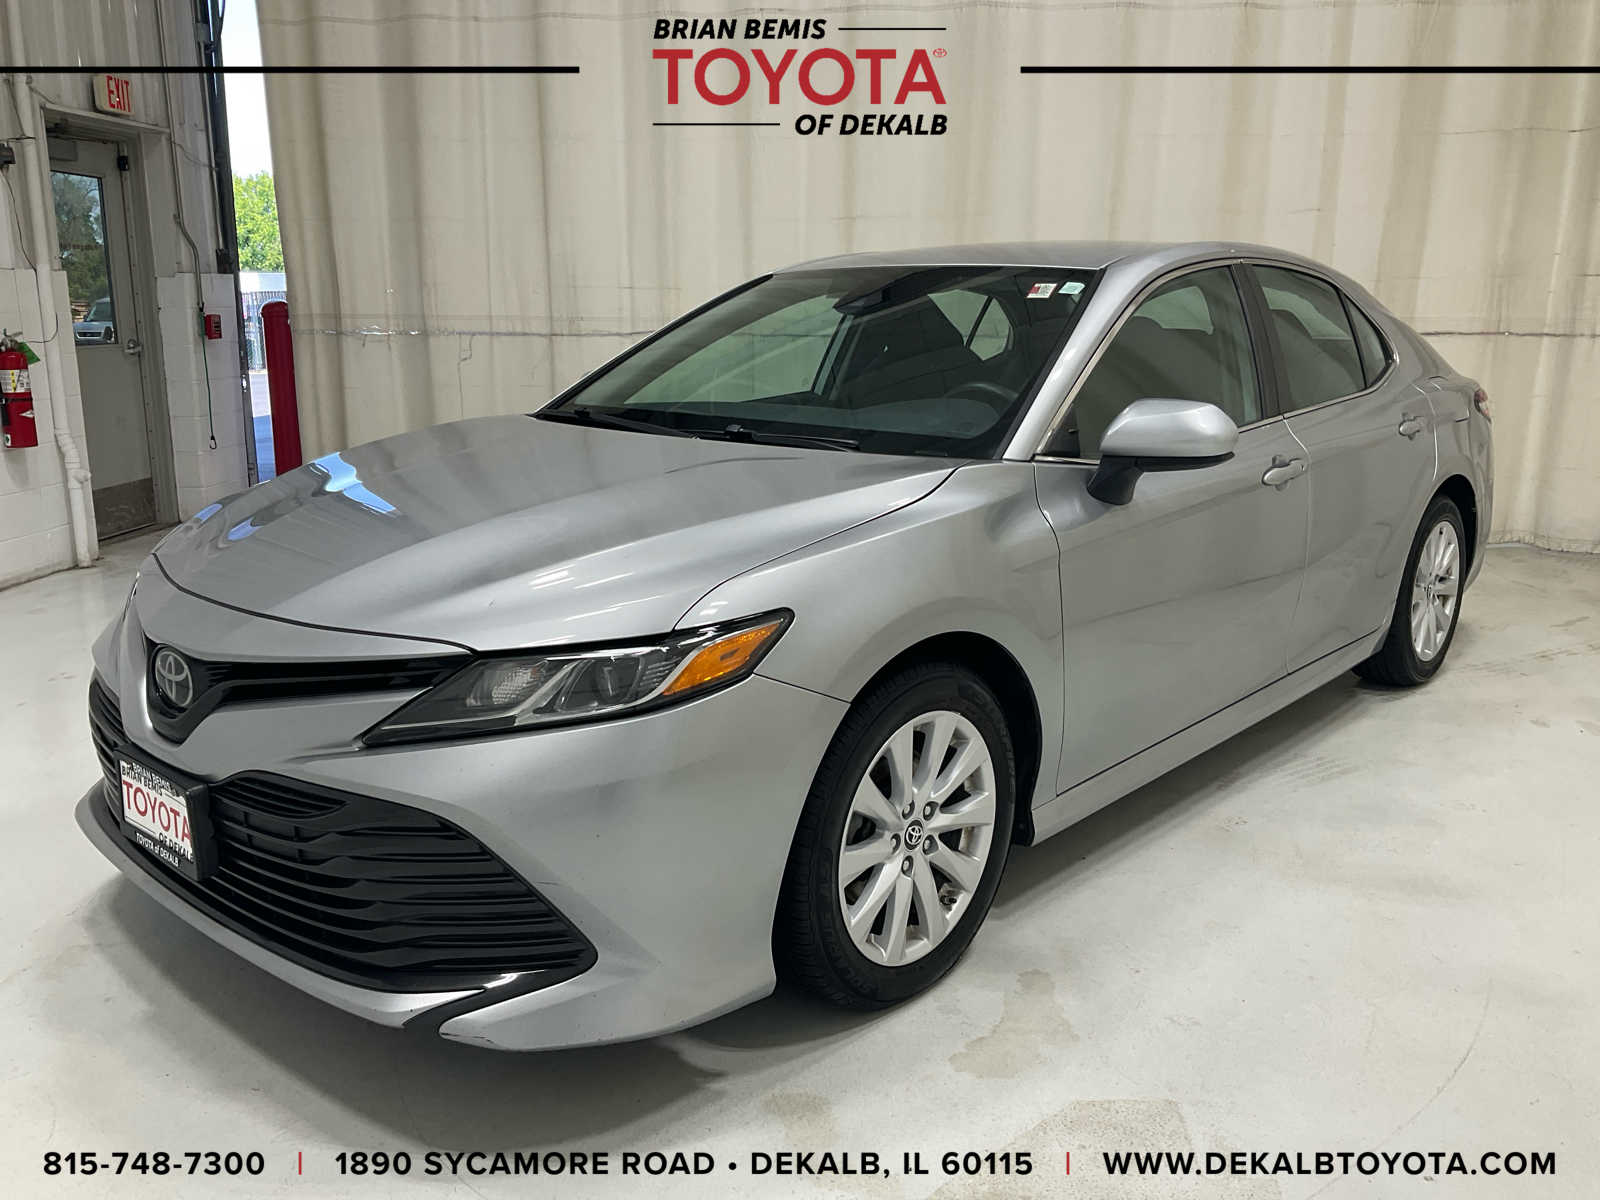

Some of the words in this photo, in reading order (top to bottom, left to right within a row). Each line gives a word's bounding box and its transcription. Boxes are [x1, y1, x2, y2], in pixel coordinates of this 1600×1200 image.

[106, 75, 131, 112] EXIT
[122, 765, 142, 785] BRIAN
[122, 780, 192, 845] TOYOTA
[136, 832, 154, 851] TOYOTA
[159, 847, 179, 868] DEKALB
